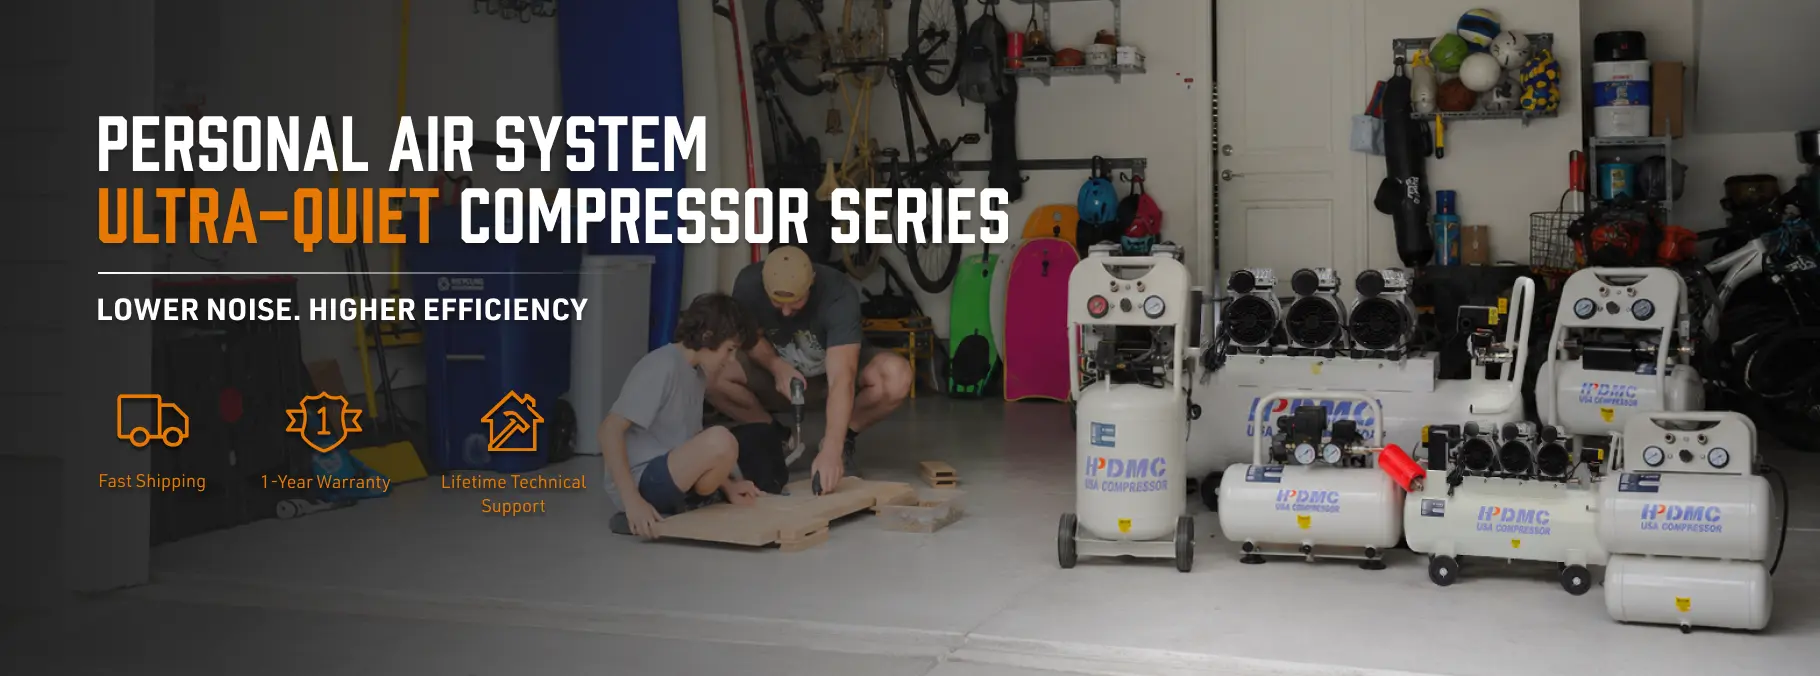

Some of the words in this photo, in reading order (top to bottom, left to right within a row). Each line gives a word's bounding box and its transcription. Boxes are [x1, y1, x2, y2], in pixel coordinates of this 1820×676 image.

[1085, 478, 1099, 490] USA
[1101, 480, 1168, 492] COMPRESSOR
[1476, 522, 1493, 532] USA
[1495, 524, 1551, 535] COMPRESSOR
[1641, 521, 1658, 531] USA
[1661, 522, 1723, 533] COMPRESSOR
